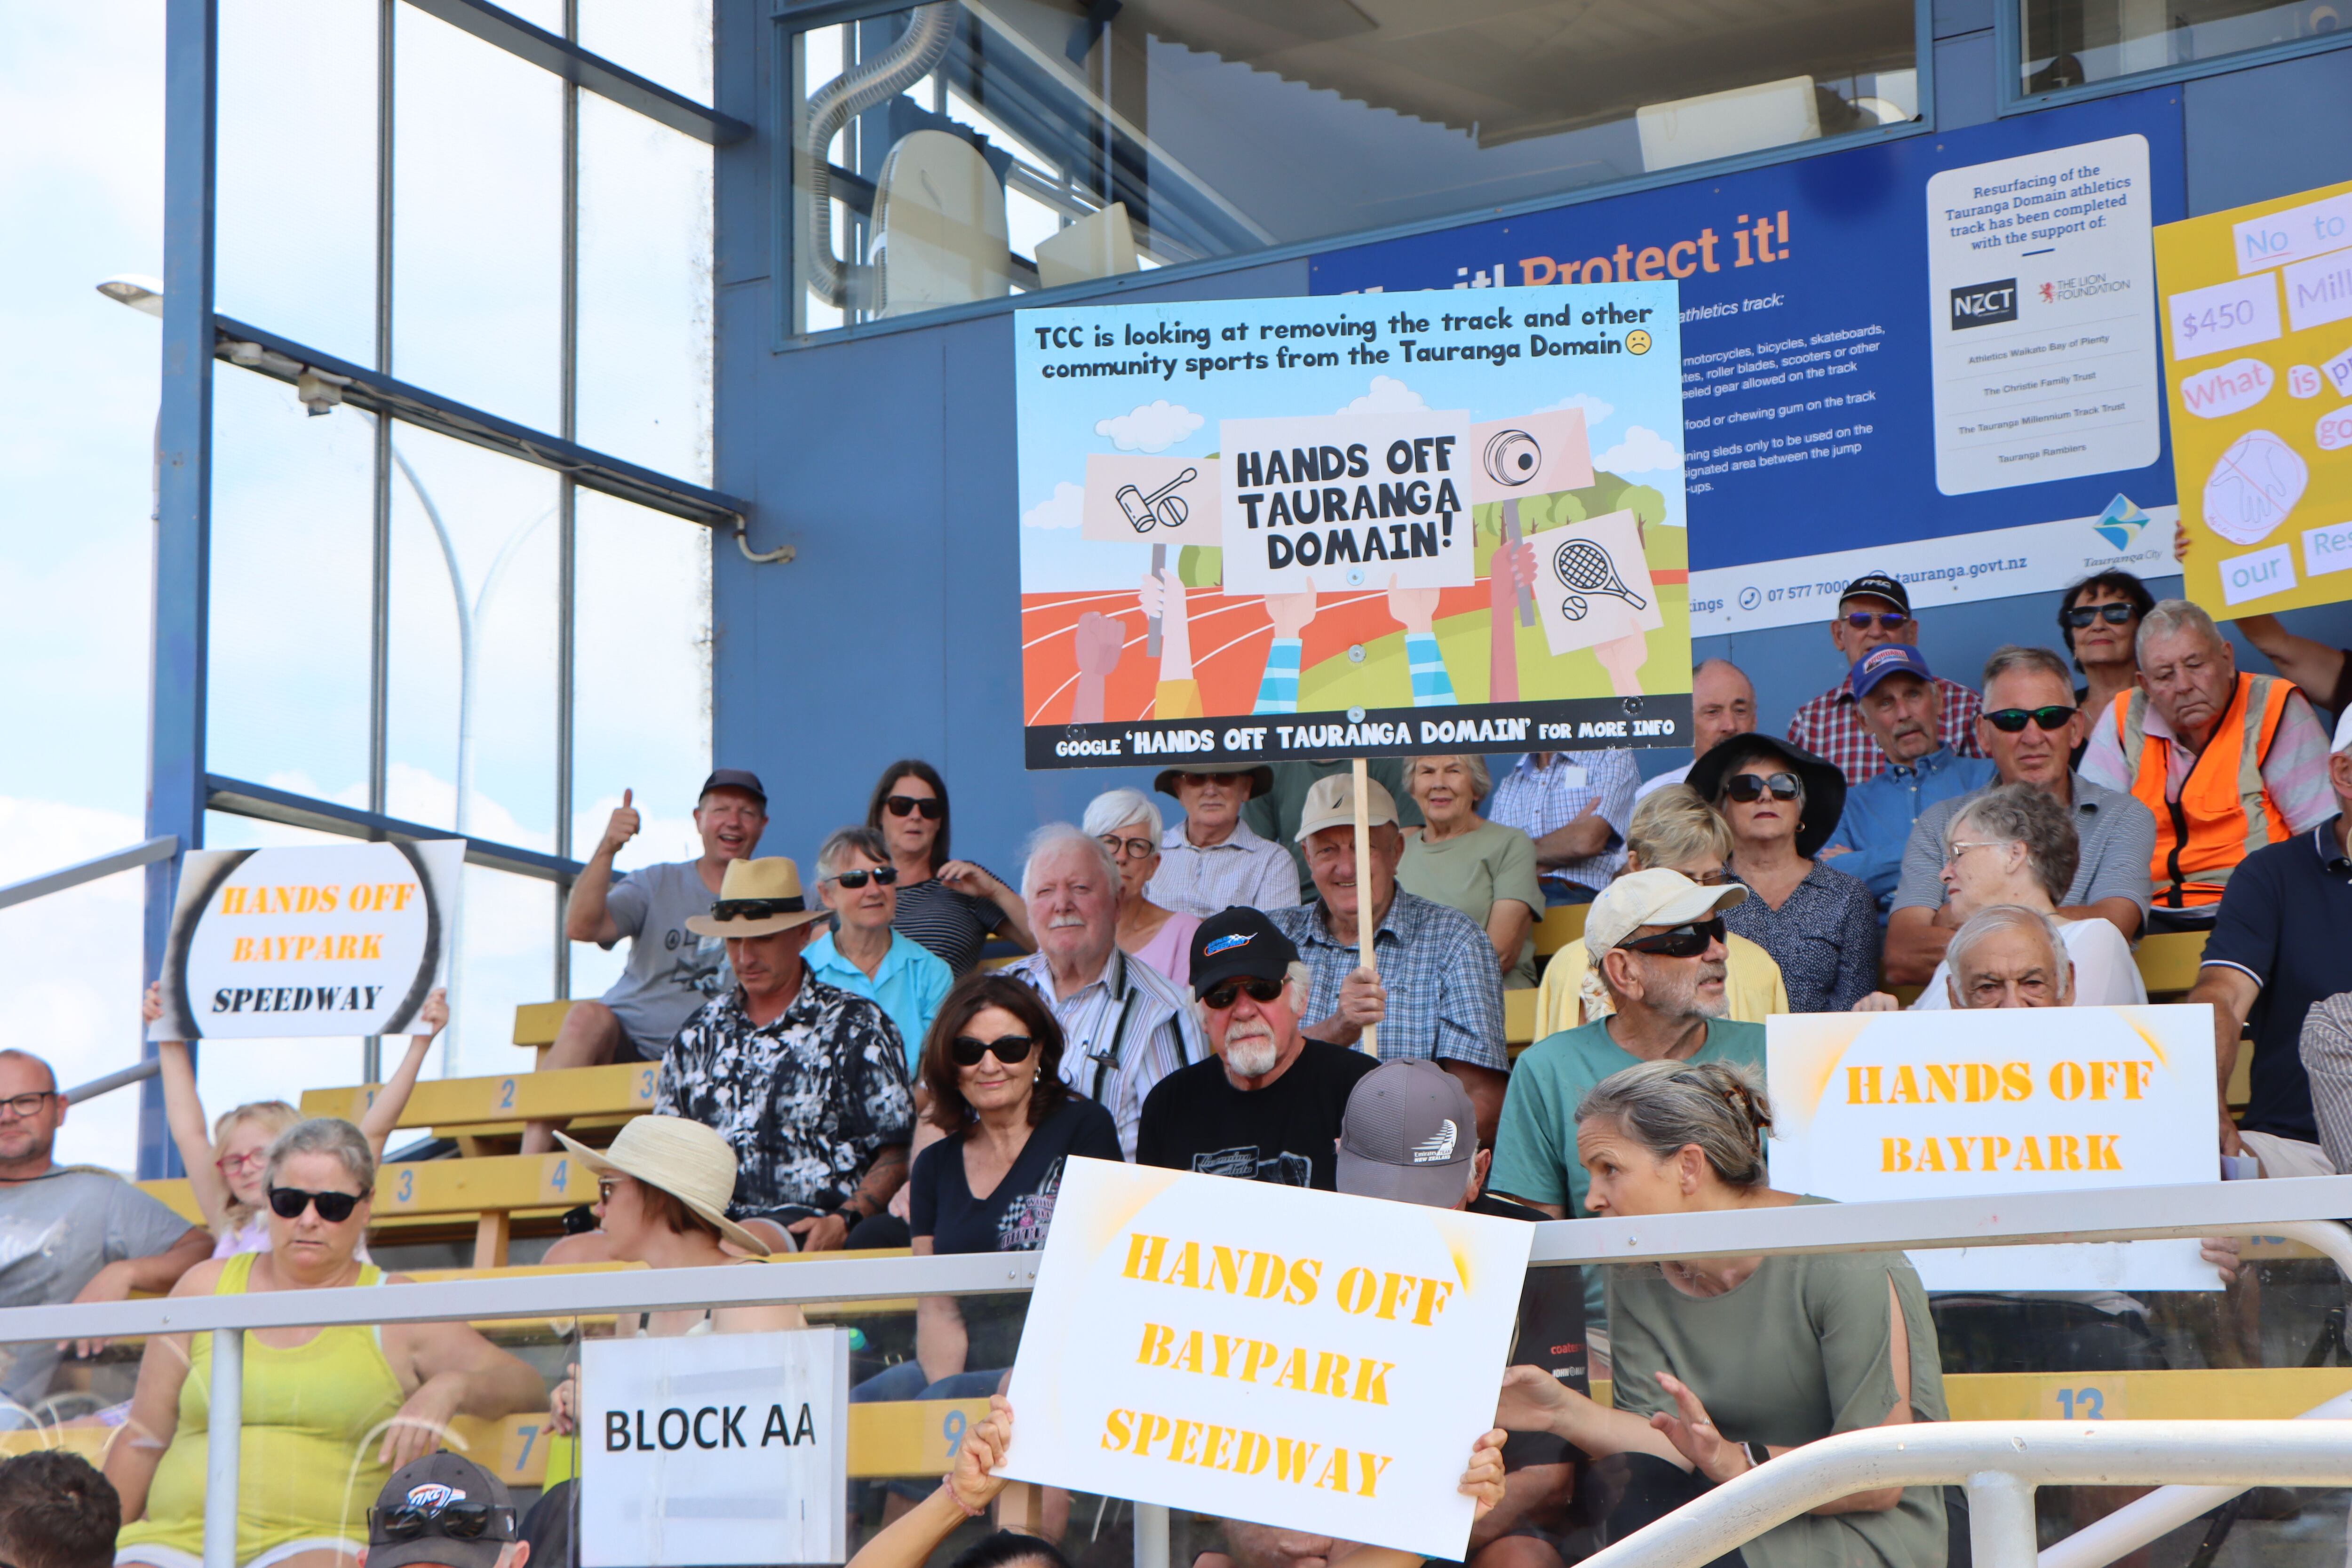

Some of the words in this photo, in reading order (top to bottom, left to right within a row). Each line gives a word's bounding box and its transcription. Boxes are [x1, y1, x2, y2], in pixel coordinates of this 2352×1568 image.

[1945, 201, 2010, 221] Tauranga
[2013, 189, 2066, 208] Domain
[2070, 177, 2131, 198] athletics
[1973, 174, 2057, 199] Resurfacing
[2060, 169, 2074, 182] of
[2078, 166, 2100, 178] the
[1951, 221, 1985, 237] track
[1988, 216, 2013, 231] has
[2017, 210, 2050, 225] been
[2054, 193, 2128, 219] completed
[1519, 228, 1720, 286] Protect
[1733, 210, 1789, 267] it!
[1971, 236, 2002, 250] with
[2006, 231, 2027, 244] the
[2032, 221, 2085, 240] support
[2246, 230, 2288, 258] No
[2313, 215, 2345, 240] to
[2057, 279, 2131, 301] FOUNDATION
[2058, 278, 2078, 289] THE
[2079, 273, 2106, 287] LION
[1679, 302, 1739, 324] athletics
[1742, 293, 1785, 312] track:
[1955, 288, 2014, 316] NZCT
[2182, 300, 2254, 341] $450
[1035, 326, 1084, 349] TCC
[1094, 325, 1114, 347] is
[1125, 321, 1210, 350] looking
[1222, 322, 1249, 341] at
[1260, 313, 1376, 342] removing
[1388, 311, 1430, 334] the
[1441, 307, 1514, 331] track
[1524, 303, 1570, 327] and
[1581, 302, 1653, 325] other
[1684, 346, 1755, 366] motorcycles,
[1757, 338, 1807, 355] bicycles,
[1810, 324, 1885, 345] skateboards,
[1042, 352, 1178, 381] community
[1185, 351, 1269, 380] sports
[1276, 346, 1339, 369] from
[1348, 342, 1391, 365] the
[1399, 340, 1521, 366] Tauranga
[1530, 331, 1621, 357] Domain
[1706, 365, 1735, 380] roller
[1737, 360, 1779, 374] blades,
[1781, 350, 1831, 366] scooters
[1834, 347, 1847, 358] or
[1849, 342, 1881, 356] other
[1969, 351, 2008, 365] Athletics
[2010, 345, 2047, 358] Waikato
[2050, 342, 2066, 352] Bay
[2069, 339, 2079, 348] of
[2081, 334, 2110, 347] Plenty
[1715, 382, 1740, 397] gear
[1742, 373, 1786, 390] allowed
[1788, 371, 1804, 382] on
[1806, 366, 1826, 378] the
[1828, 361, 1857, 375] track
[1984, 388, 2001, 397] The
[2004, 381, 2038, 393] Christie
[2041, 376, 2071, 389] Family
[2073, 371, 2096, 382] Trust
[2184, 364, 2267, 409] What
[2291, 369, 2317, 395] is
[1685, 415, 1710, 430] food
[1713, 415, 1725, 426] or
[1727, 407, 1775, 424] chewing
[1777, 403, 1804, 418] gum
[1806, 400, 1822, 412] on
[1824, 396, 1844, 408] the
[1845, 390, 1876, 405] track
[1959, 426, 1976, 435] The
[1978, 419, 2019, 433] Tauranga
[2022, 412, 2072, 425] Millennium
[2074, 406, 2099, 417] Track
[2102, 402, 2126, 413] Trust
[1712, 443, 1743, 458] sleds
[1744, 439, 1770, 454] only
[1771, 437, 1784, 449] to
[1786, 433, 1802, 447] be
[1804, 429, 1833, 444] used
[1835, 427, 1851, 438] on
[1853, 423, 1873, 435] the
[1731, 459, 1756, 471] area
[1758, 451, 1808, 468] between
[1810, 446, 1830, 459] the
[1831, 442, 1862, 458] jump
[1998, 451, 2041, 464] Tauranga
[2043, 443, 2087, 457] Ramblers
[1237, 443, 1369, 487] HANDS
[1386, 435, 1456, 474] OFF
[1238, 478, 1462, 529] TAURANGA
[1267, 510, 1453, 569] DOMAIN!
[2084, 553, 2144, 567] Tauranga
[2145, 549, 2164, 560] City
[1895, 557, 2027, 583] tauranga.govt.nz
[2232, 558, 2280, 589] our
[1769, 588, 1783, 602] 07
[1788, 585, 1812, 599] 577
[1817, 580, 1849, 596] 7000
[1056, 739, 1121, 757] GOOGLE
[1223, 727, 1267, 751] OFF
[1276, 722, 1412, 749] TAURANGA
[1538, 723, 1572, 740] FOR
[1578, 721, 1627, 738] MORE
[1632, 719, 1675, 737] INFO
[220, 884, 341, 915] HANDS
[348, 882, 416, 912] OFF
[231, 933, 385, 963] BAYPARK
[212, 986, 383, 1013] SPEEDWAY
[499, 1078, 516, 1109] 2
[640, 1069, 656, 1099] 3
[1845, 1062, 2034, 1105] HANDS
[2048, 1060, 2154, 1101] OFF
[1880, 1134, 2124, 1172] BAYPARK
[397, 1169, 413, 1202] 3
[551, 1159, 568, 1193] 4
[1120, 1233, 1323, 1307] HANDS
[1336, 1266, 1454, 1327] OFF
[1135, 1322, 1397, 1407] BAYPARK
[516, 1425, 539, 1471] 7
[943, 1409, 968, 1457] 9
[2056, 1387, 2104, 1420] 13
[605, 1405, 748, 1452] BLOCK
[760, 1402, 816, 1447] AA
[1100, 1408, 1393, 1498] SPEEDWAY
